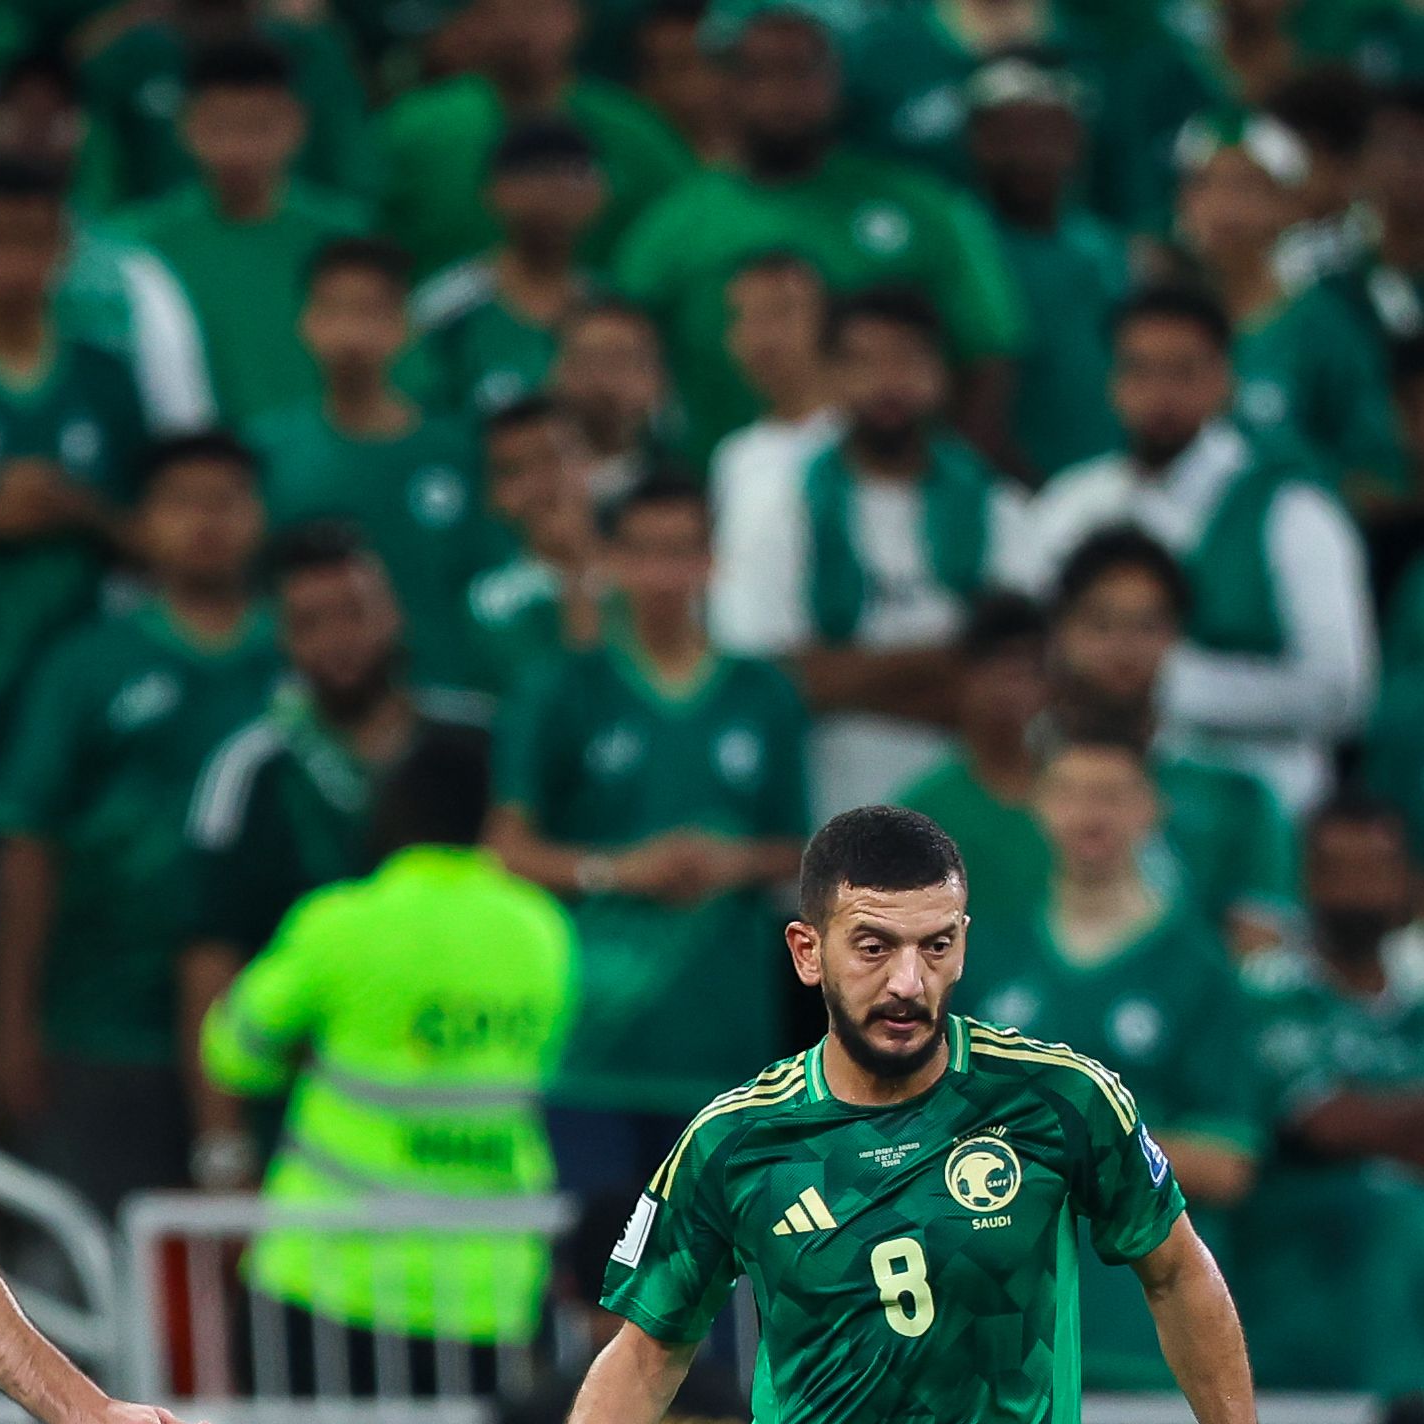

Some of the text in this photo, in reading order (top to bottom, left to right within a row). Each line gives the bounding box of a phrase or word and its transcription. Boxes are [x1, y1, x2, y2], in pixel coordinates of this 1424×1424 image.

[987, 1179, 1009, 1189] SAFF
[971, 1215, 1012, 1230] SAUDI
[870, 1237, 935, 1338] 8
